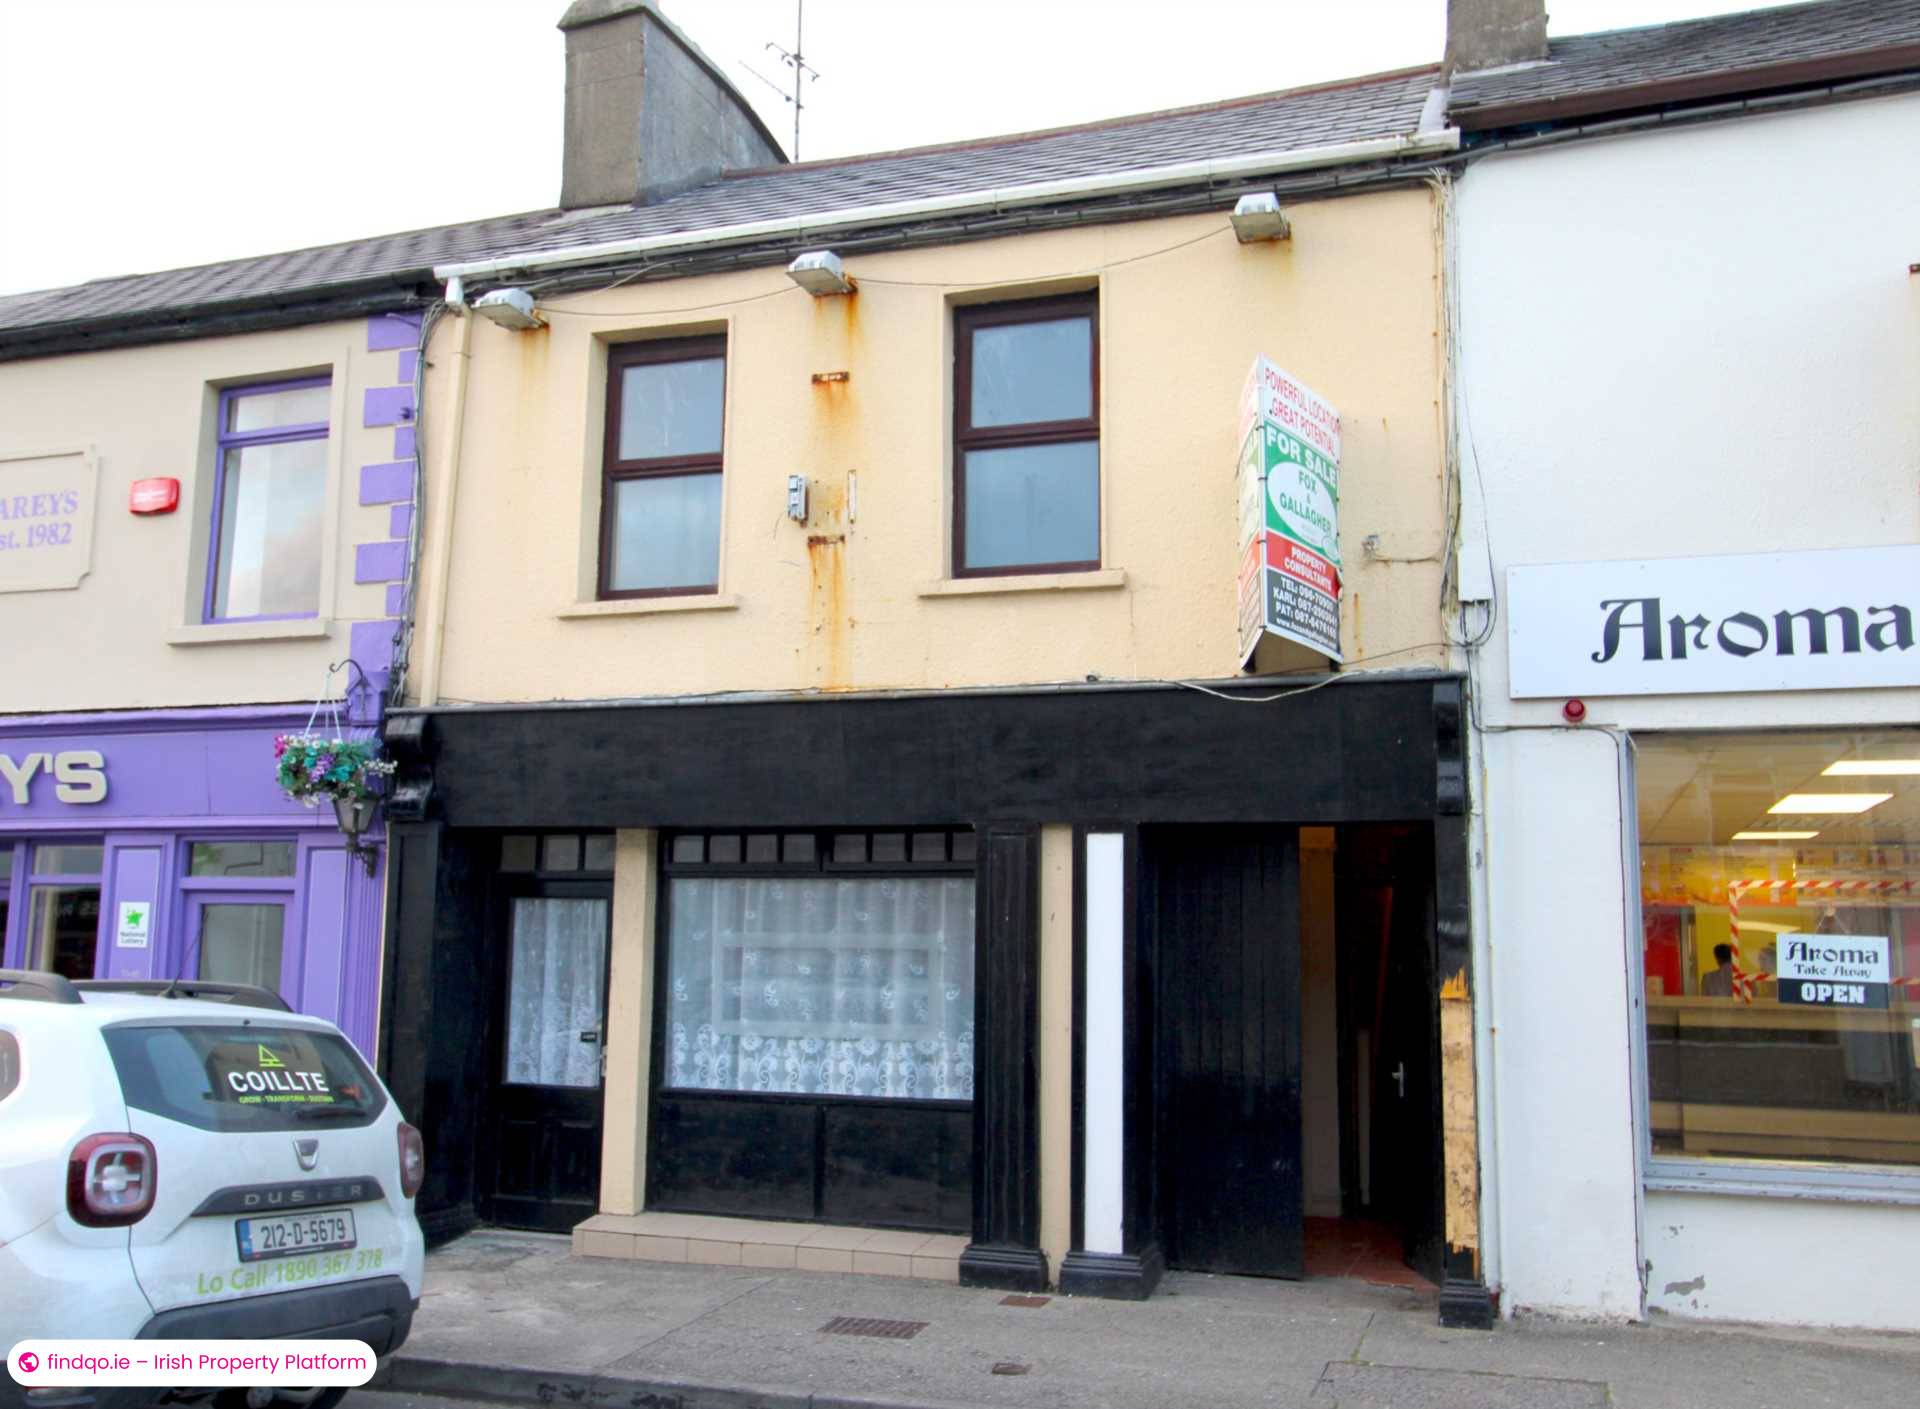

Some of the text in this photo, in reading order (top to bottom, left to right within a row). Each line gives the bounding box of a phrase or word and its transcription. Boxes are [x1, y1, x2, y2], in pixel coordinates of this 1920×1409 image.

[1265, 368, 1307, 412] POWERFUL
[1272, 398, 1298, 430] GREAT
[1266, 425, 1337, 490] FOR SALE
[1298, 471, 1317, 494] FOX
[1279, 491, 1331, 532] GALLAGHER
[26, 521, 72, 548] 1982
[1291, 546, 1327, 575] PROPERTY
[1281, 576, 1297, 590] TEL:
[1273, 587, 1296, 608] KARL:
[1275, 601, 1294, 618] PAT:
[1591, 597, 1915, 663] Aroma
[1786, 941, 1879, 964] Aroma
[1794, 963, 1872, 978] Take Away
[1801, 982, 1865, 1004] OPEN
[228, 1071, 330, 1092] COILLTE
[260, 1218, 346, 1249] 212-D-5679
[197, 1248, 384, 1296] Lo Call 1890 367 378
